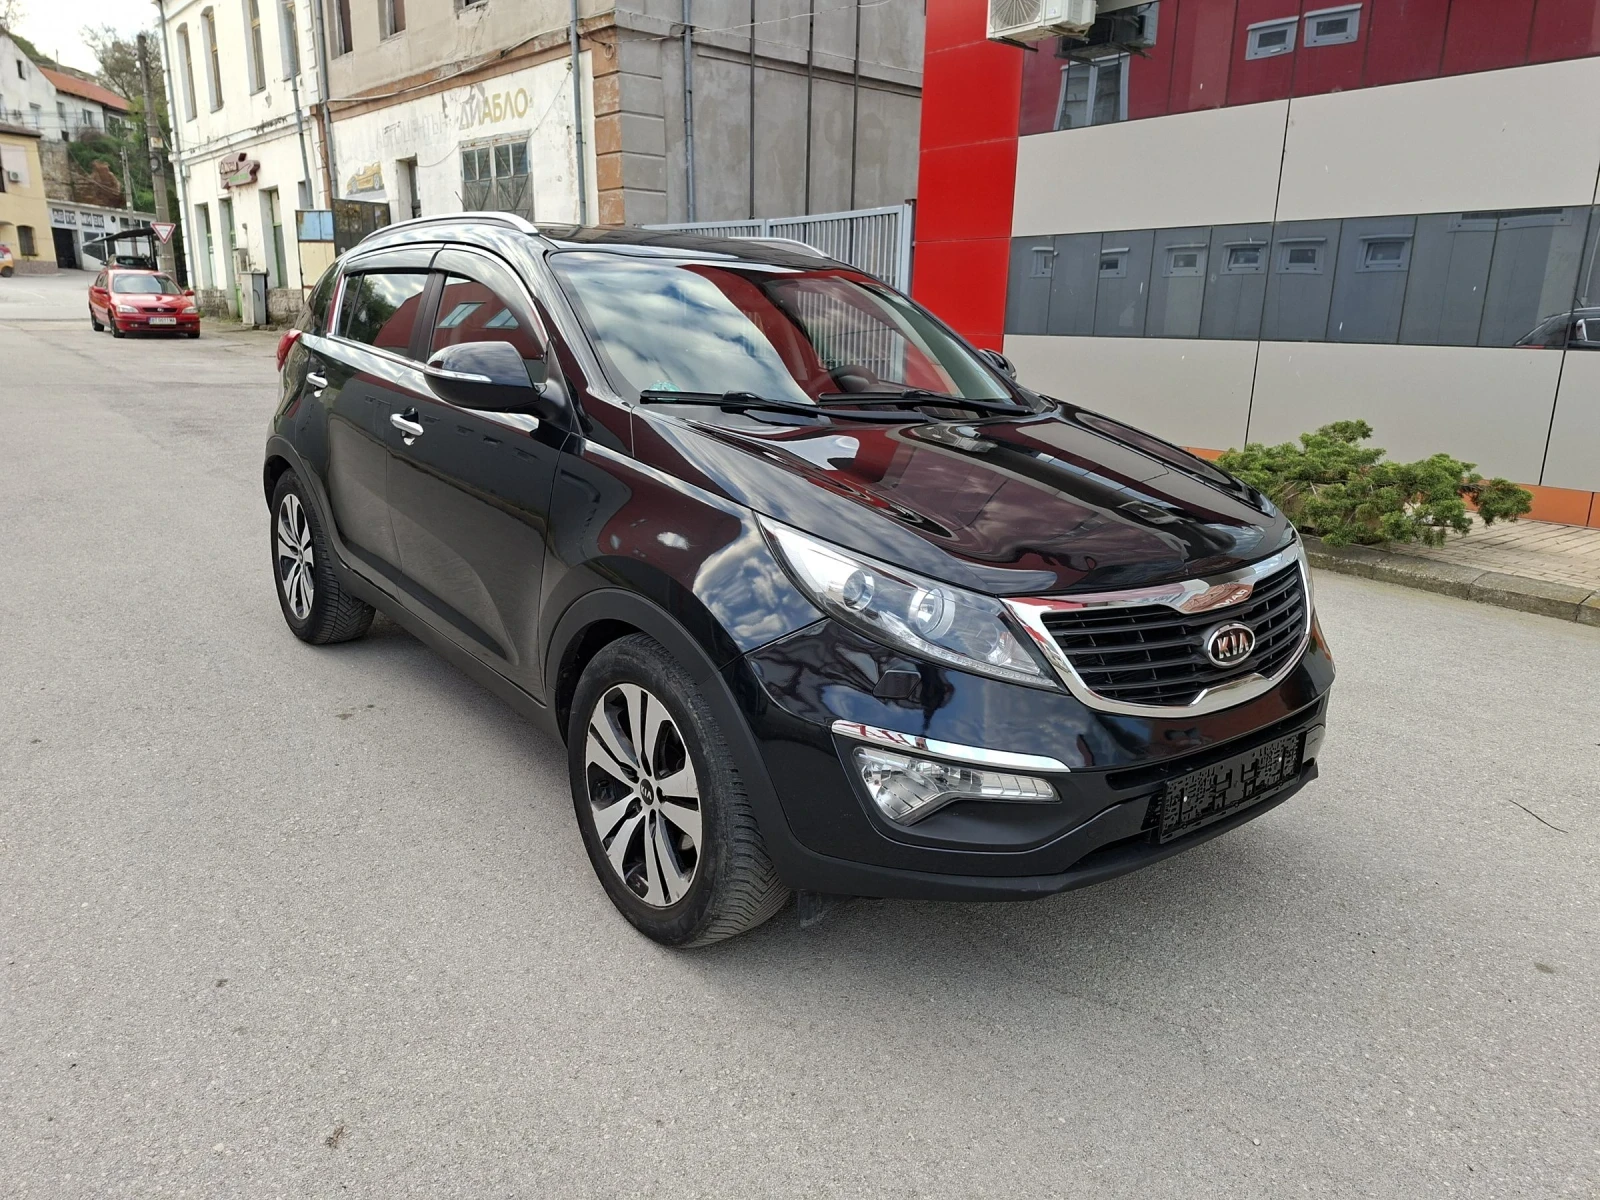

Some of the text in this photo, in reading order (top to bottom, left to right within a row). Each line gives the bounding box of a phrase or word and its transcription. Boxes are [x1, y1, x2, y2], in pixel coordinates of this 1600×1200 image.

[459, 87, 529, 131] ДИАБЛО
[1217, 632, 1249, 659] KIA
[640, 784, 652, 800] KIA
